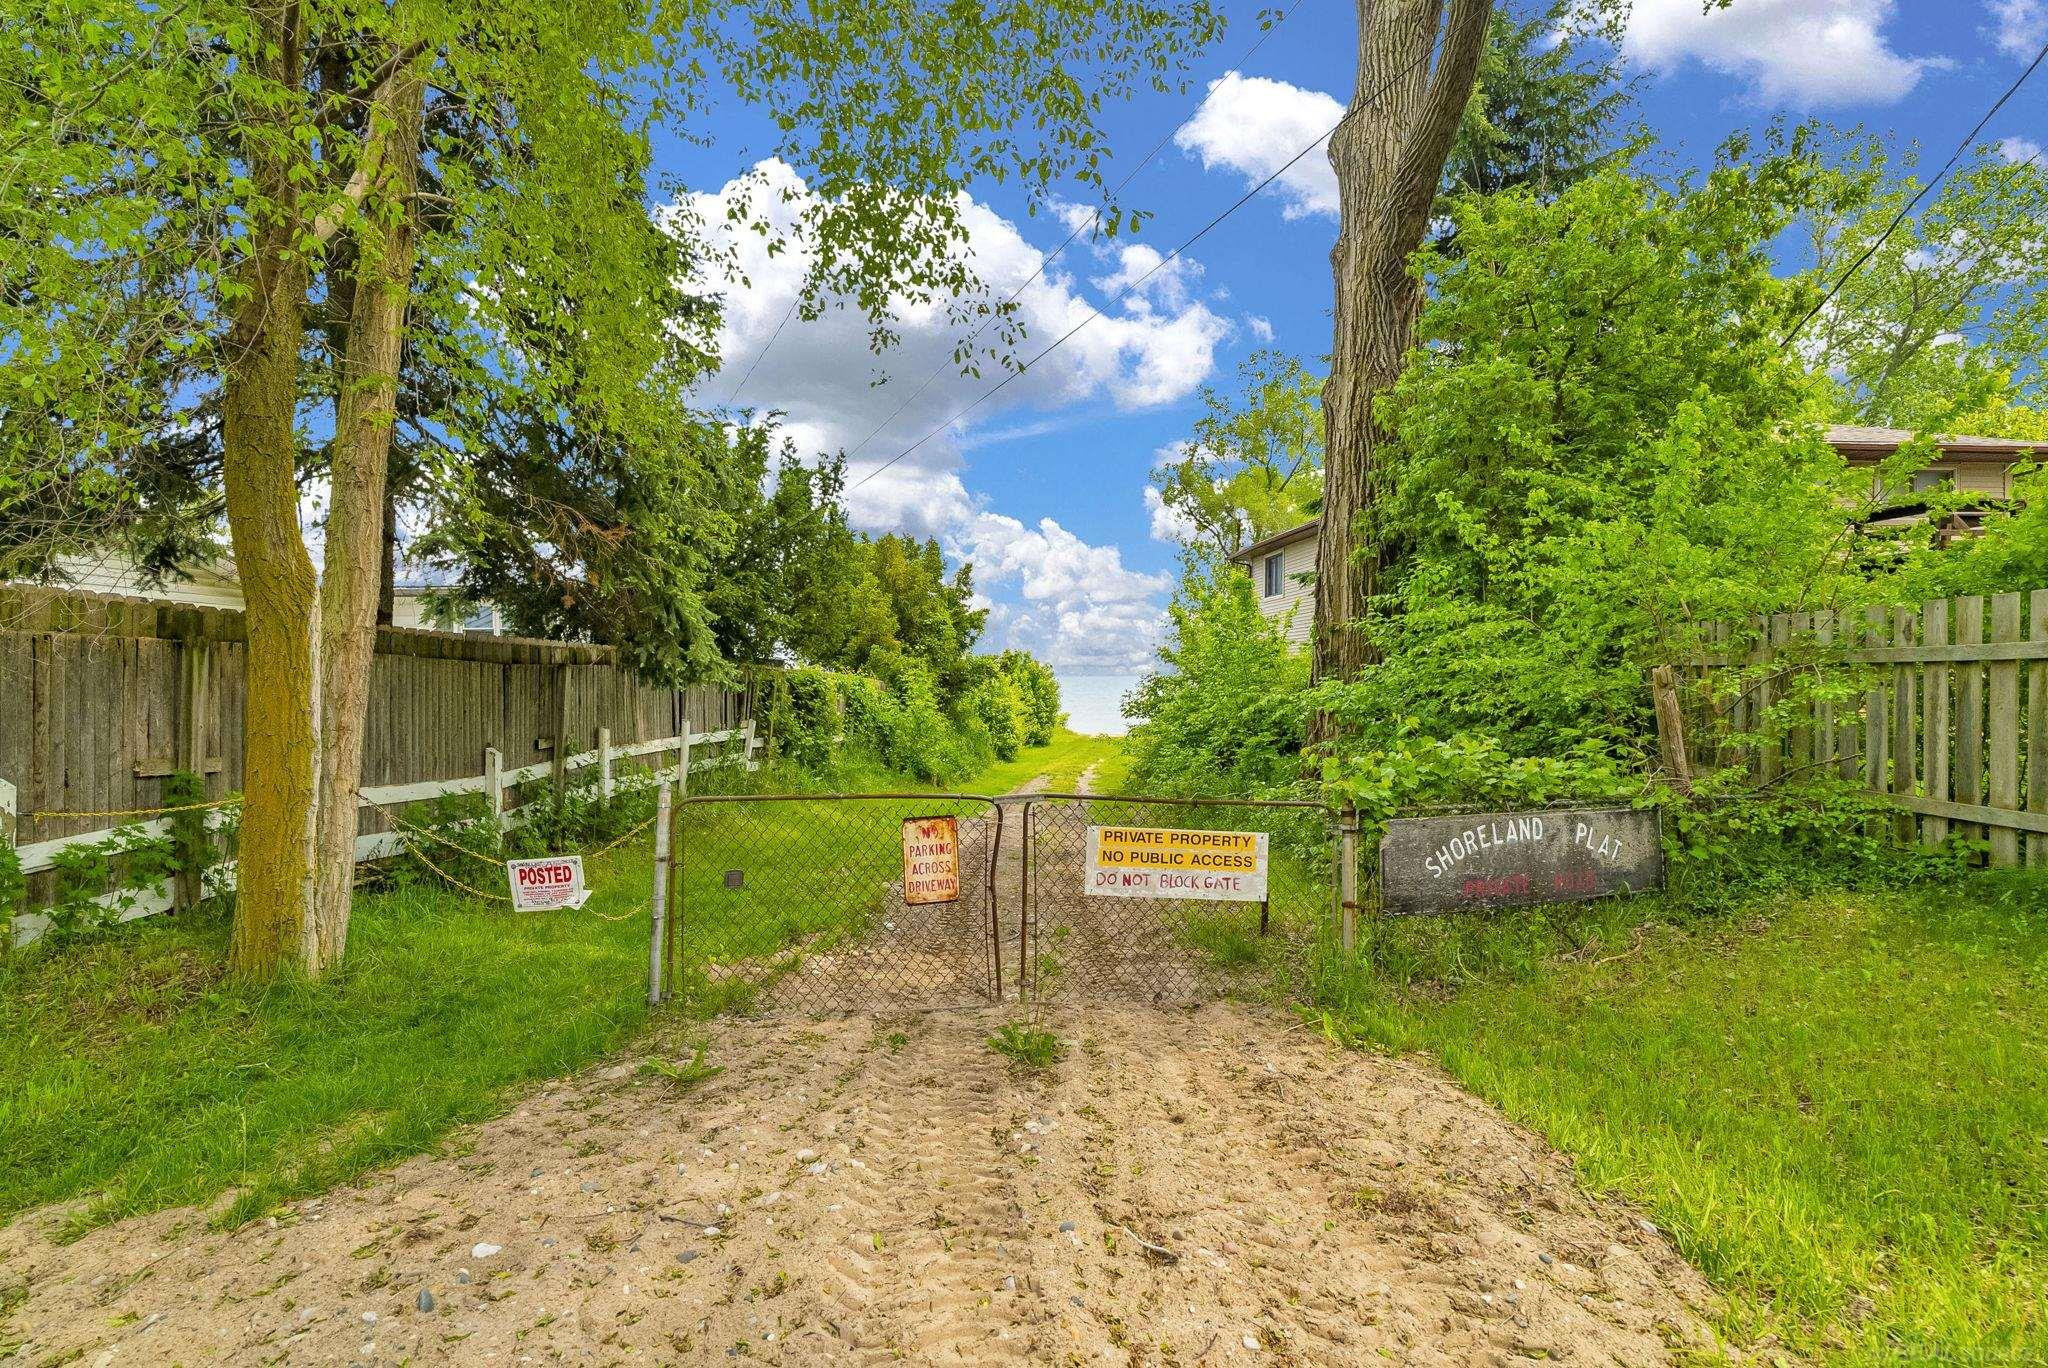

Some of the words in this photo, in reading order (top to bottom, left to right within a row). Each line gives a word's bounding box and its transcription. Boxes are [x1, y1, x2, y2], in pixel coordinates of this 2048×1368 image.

[921, 825, 938, 840] NO
[1104, 831, 1164, 844] PRIVATE
[1170, 834, 1251, 848] PROPERTY
[909, 842, 952, 858] PARKING
[1425, 817, 1543, 879] SHORELAND
[1575, 822, 1622, 861] PLAT
[1102, 850, 1124, 863] NO
[1130, 852, 1184, 865] PUBLIC
[1190, 854, 1253, 868] ACCESS
[519, 865, 572, 885] POSTED
[912, 861, 951, 875] ACROSS
[908, 878, 957, 893] DRIVEWAY
[1096, 873, 1117, 886] DO
[1122, 873, 1150, 887] NOT
[1160, 874, 1199, 889] BLOCK
[1204, 876, 1241, 891] GATE
